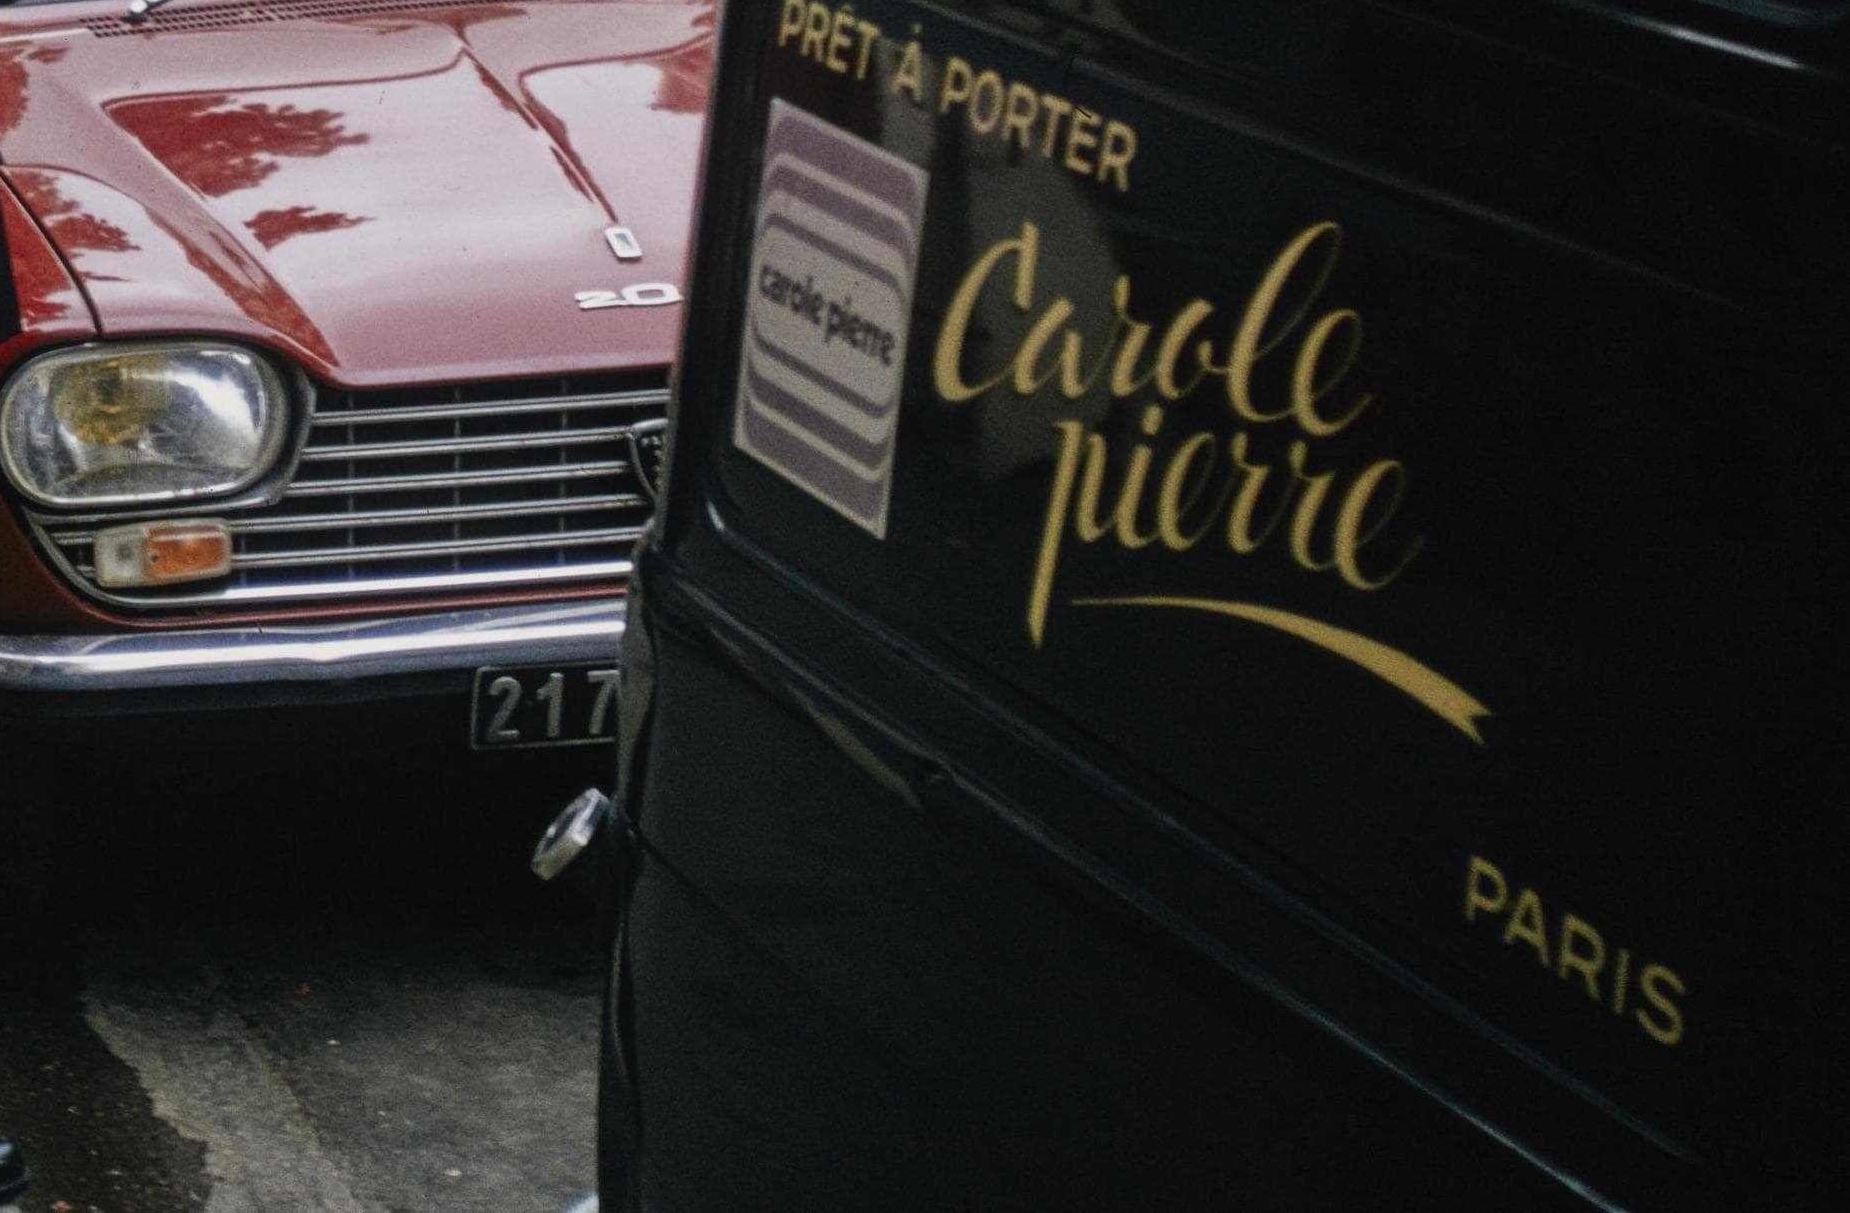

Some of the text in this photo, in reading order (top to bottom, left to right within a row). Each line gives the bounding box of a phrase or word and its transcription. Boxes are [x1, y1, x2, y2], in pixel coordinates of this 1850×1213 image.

[940, 56, 1137, 192] PORTER
[759, 264, 896, 368] carole pierre
[933, 220, 1373, 437] Carole
[1028, 404, 1425, 651] pierre
[487, 668, 622, 738] 217
[1465, 854, 1686, 1048] PARIS
